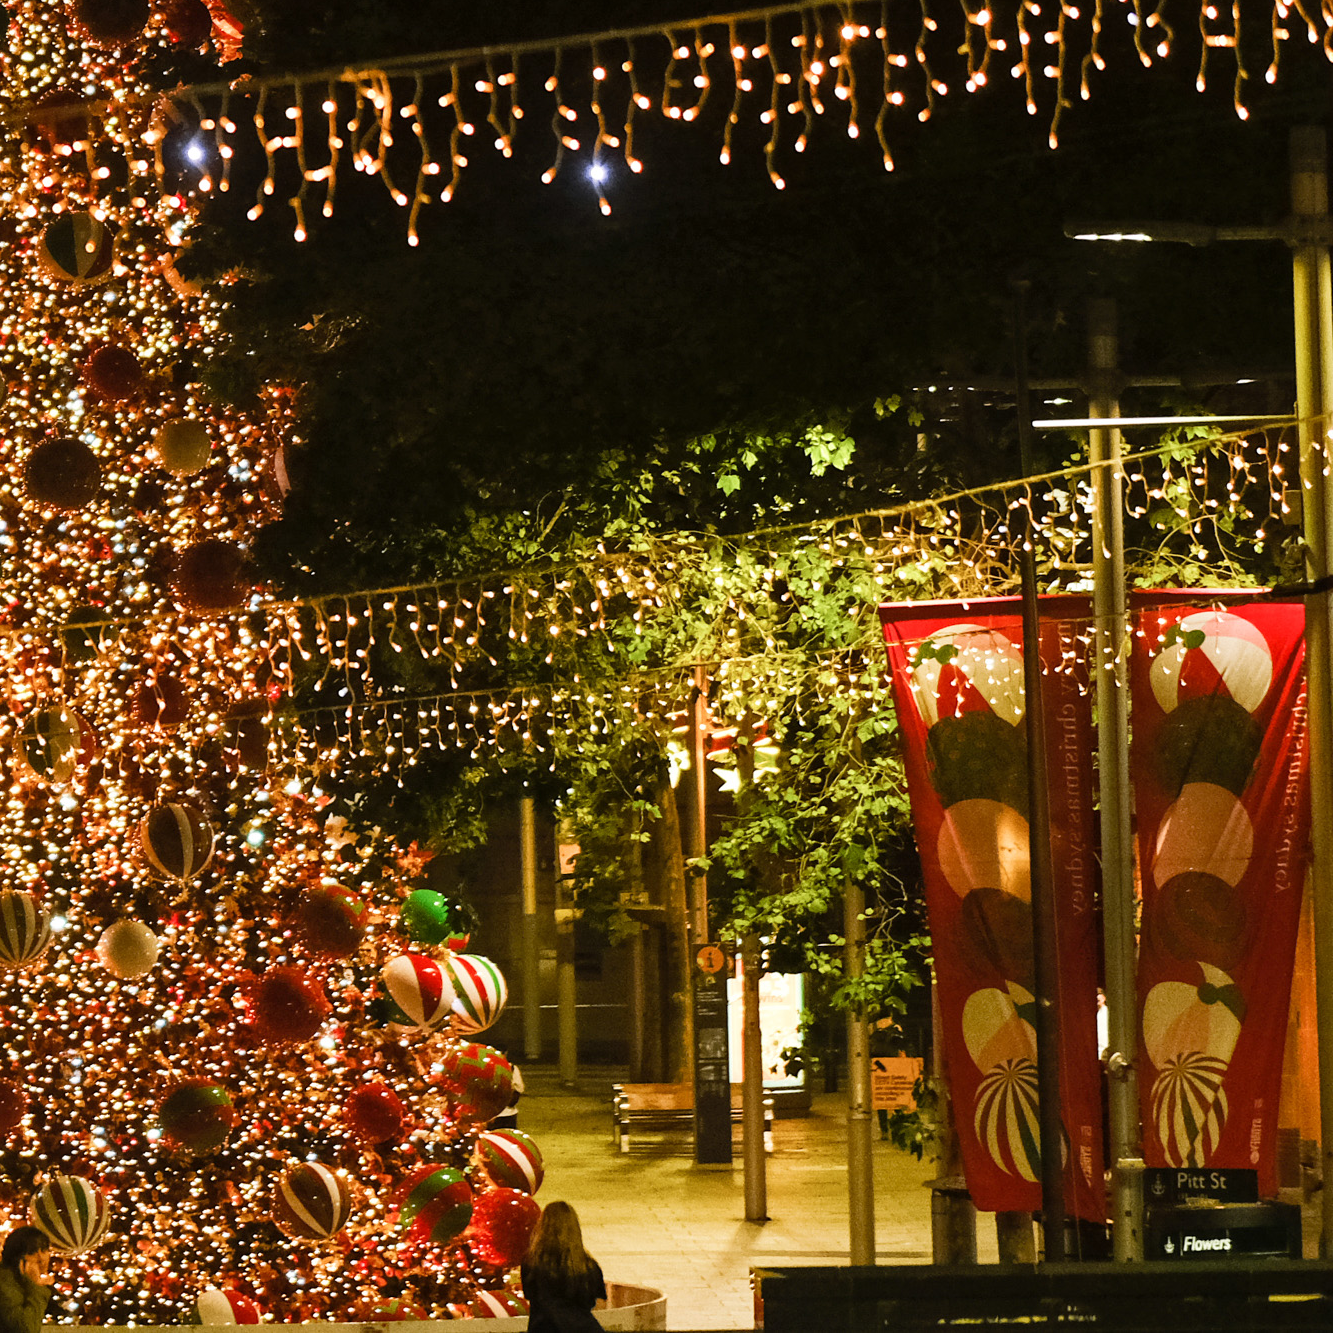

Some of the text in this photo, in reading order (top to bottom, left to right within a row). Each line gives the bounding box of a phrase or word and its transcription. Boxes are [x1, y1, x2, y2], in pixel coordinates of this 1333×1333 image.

[1177, 1172, 1228, 1190] Pitt St
[1183, 1235, 1233, 1252] Flowers
